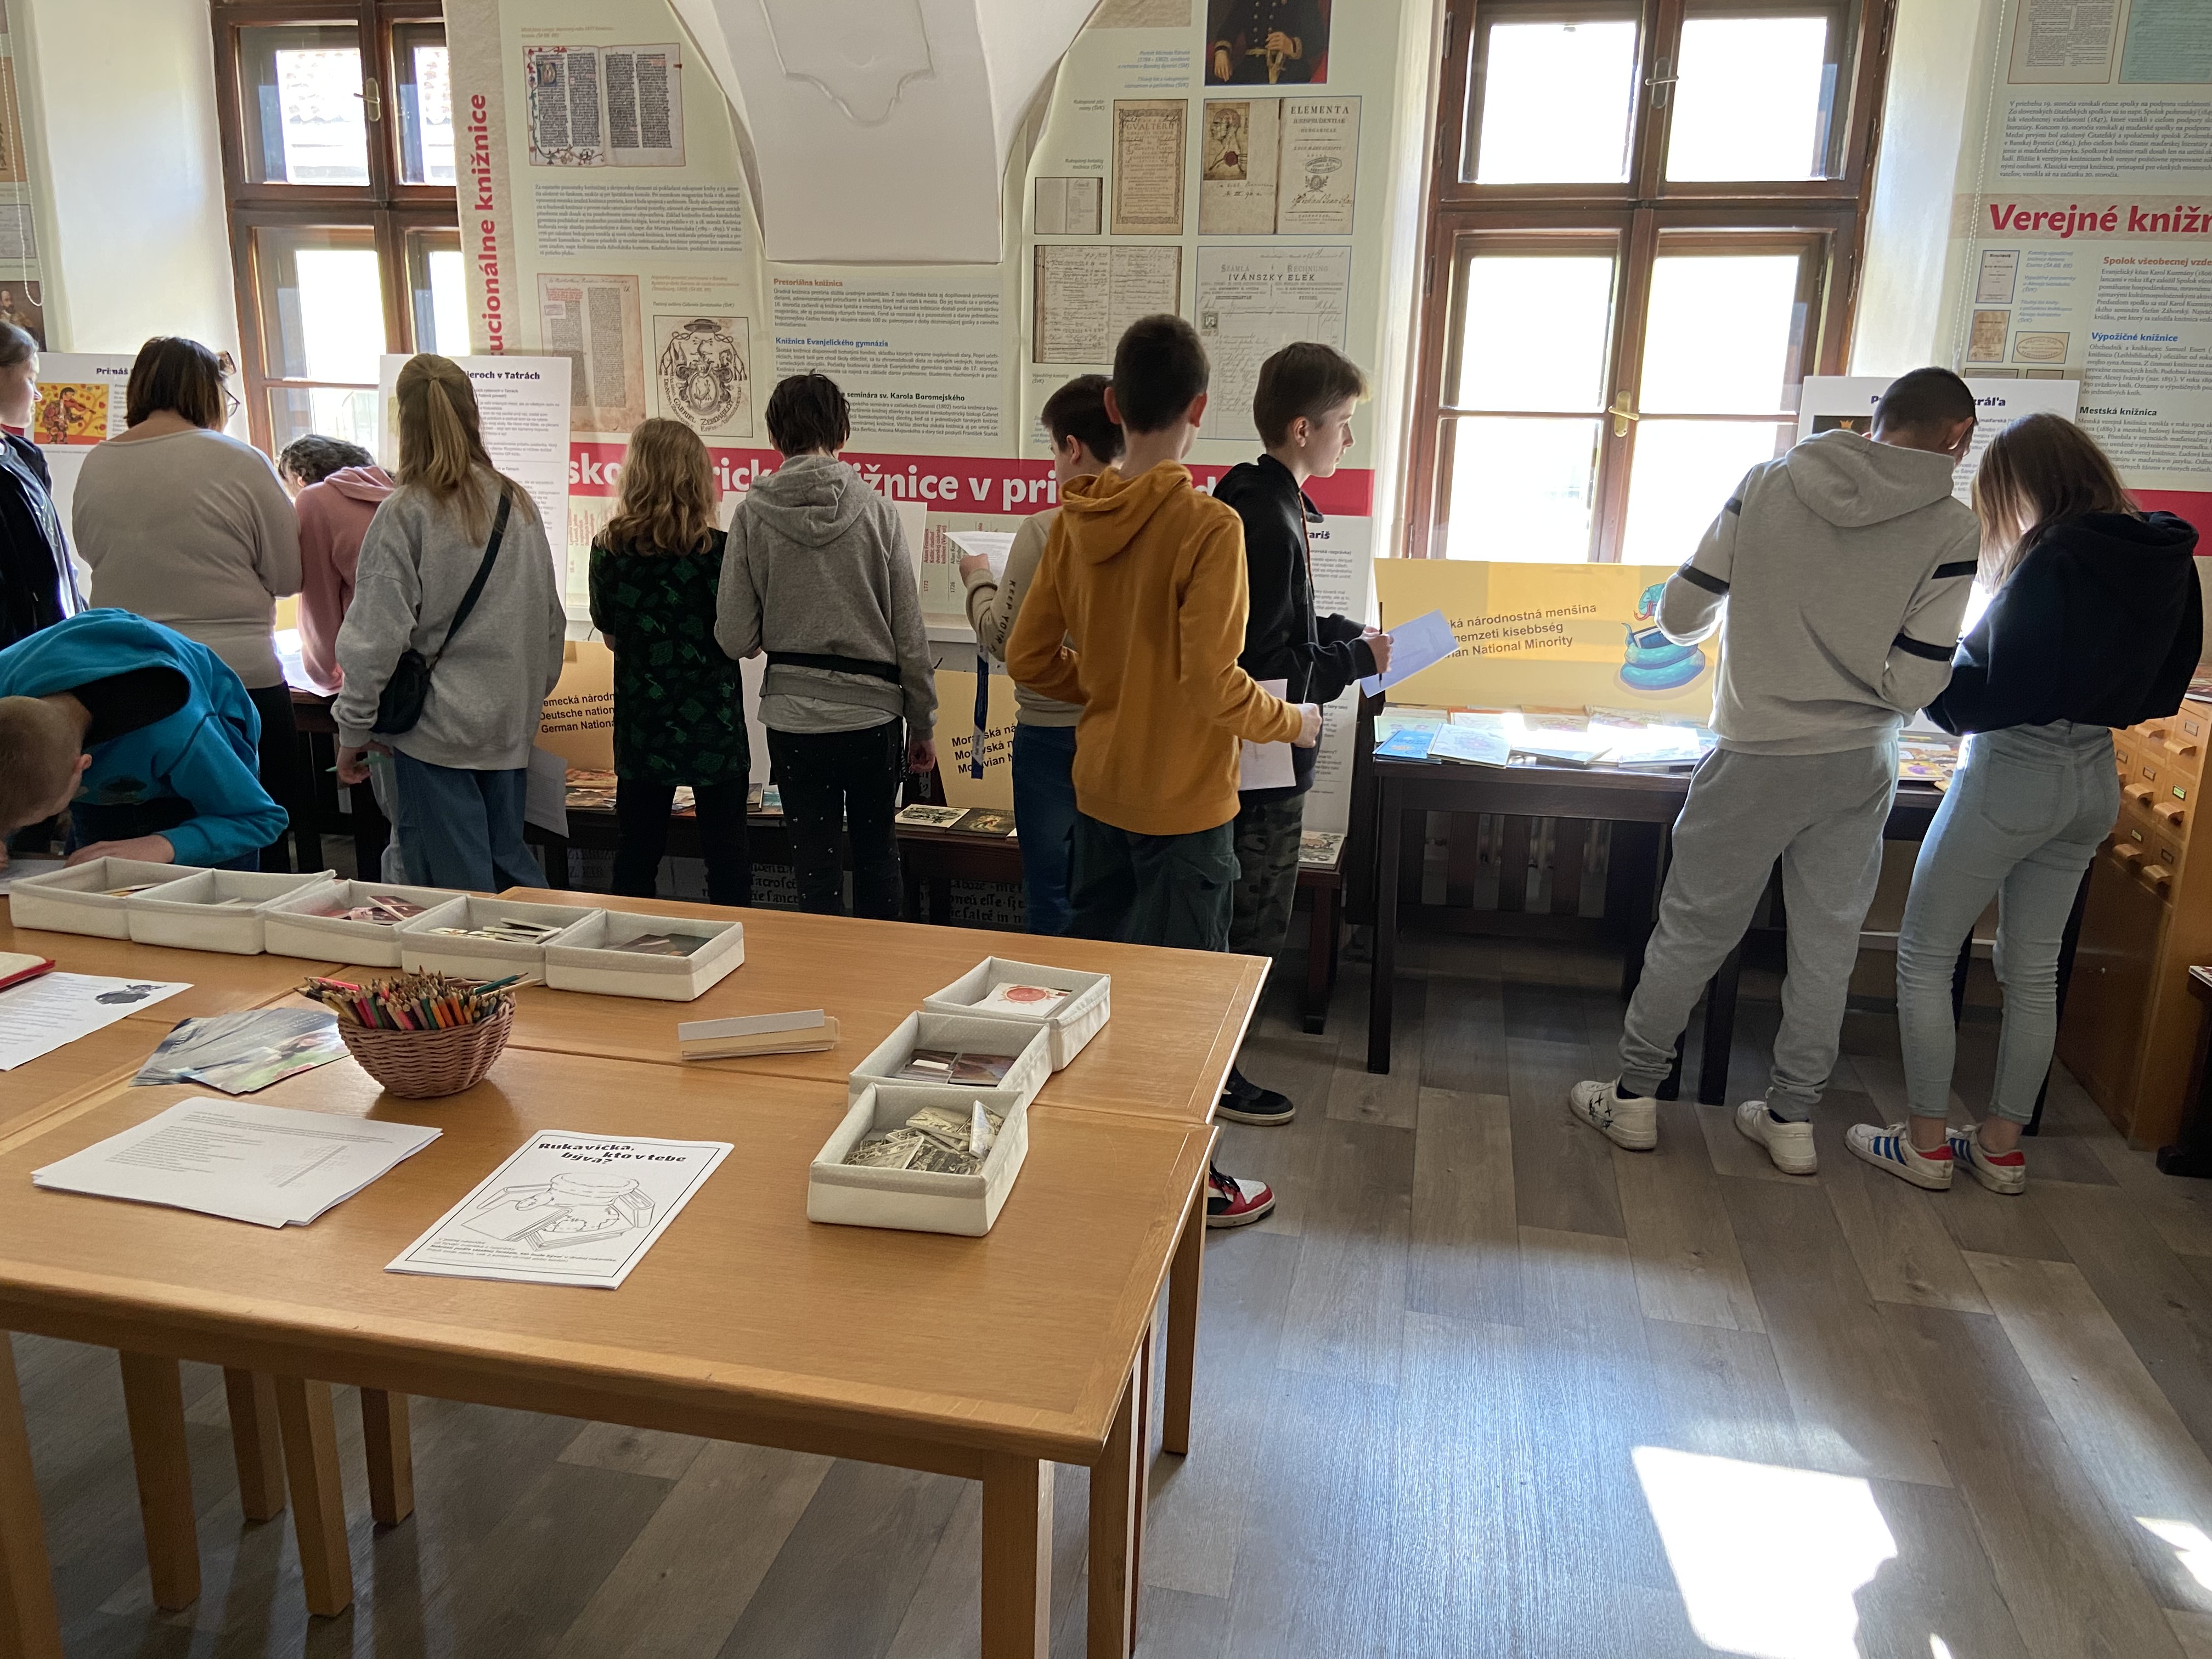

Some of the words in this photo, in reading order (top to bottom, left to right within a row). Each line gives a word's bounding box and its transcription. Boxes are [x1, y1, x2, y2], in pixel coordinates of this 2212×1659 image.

[1291, 106, 1350, 114] ELEMENTA
[468, 93, 494, 211] knižnice
[1990, 204, 2118, 239] Verejné
[2103, 256, 2136, 266] Spolok
[2137, 257, 2188, 267] všeobecnej
[1228, 273, 1283, 281] IVÁNSZKY
[476, 220, 504, 355] ucionálne
[807, 338, 854, 347] Evanjelického
[2091, 332, 2138, 342] Výpožičné
[2140, 333, 2178, 342] knižnice
[505, 371, 540, 380] Tatrách
[915, 393, 965, 402] Boromejského
[674, 398, 696, 423] GABRIEL
[2079, 406, 2118, 415] Mestská
[2120, 407, 2157, 416] knižnica
[968, 477, 992, 501] v
[1307, 530, 1330, 539] ariš
[1006, 579, 1015, 611] KEEP
[1448, 618, 1463, 629] ká
[1467, 609, 1542, 627] národnostná
[1545, 603, 1596, 617] menšina
[995, 615, 1009, 645] YOUR
[1454, 628, 1499, 642] nemzeti
[1502, 621, 1564, 639] kisebbség
[1472, 641, 1521, 655] National
[1524, 636, 1573, 651] Minority
[543, 695, 579, 707] emecká
[541, 724, 578, 733] German
[538, 1142, 635, 1152] Rukavička,
[561, 1152, 613, 1165] býva?
[602, 1151, 632, 1160] kto
[647, 1153, 686, 1163] tebe
